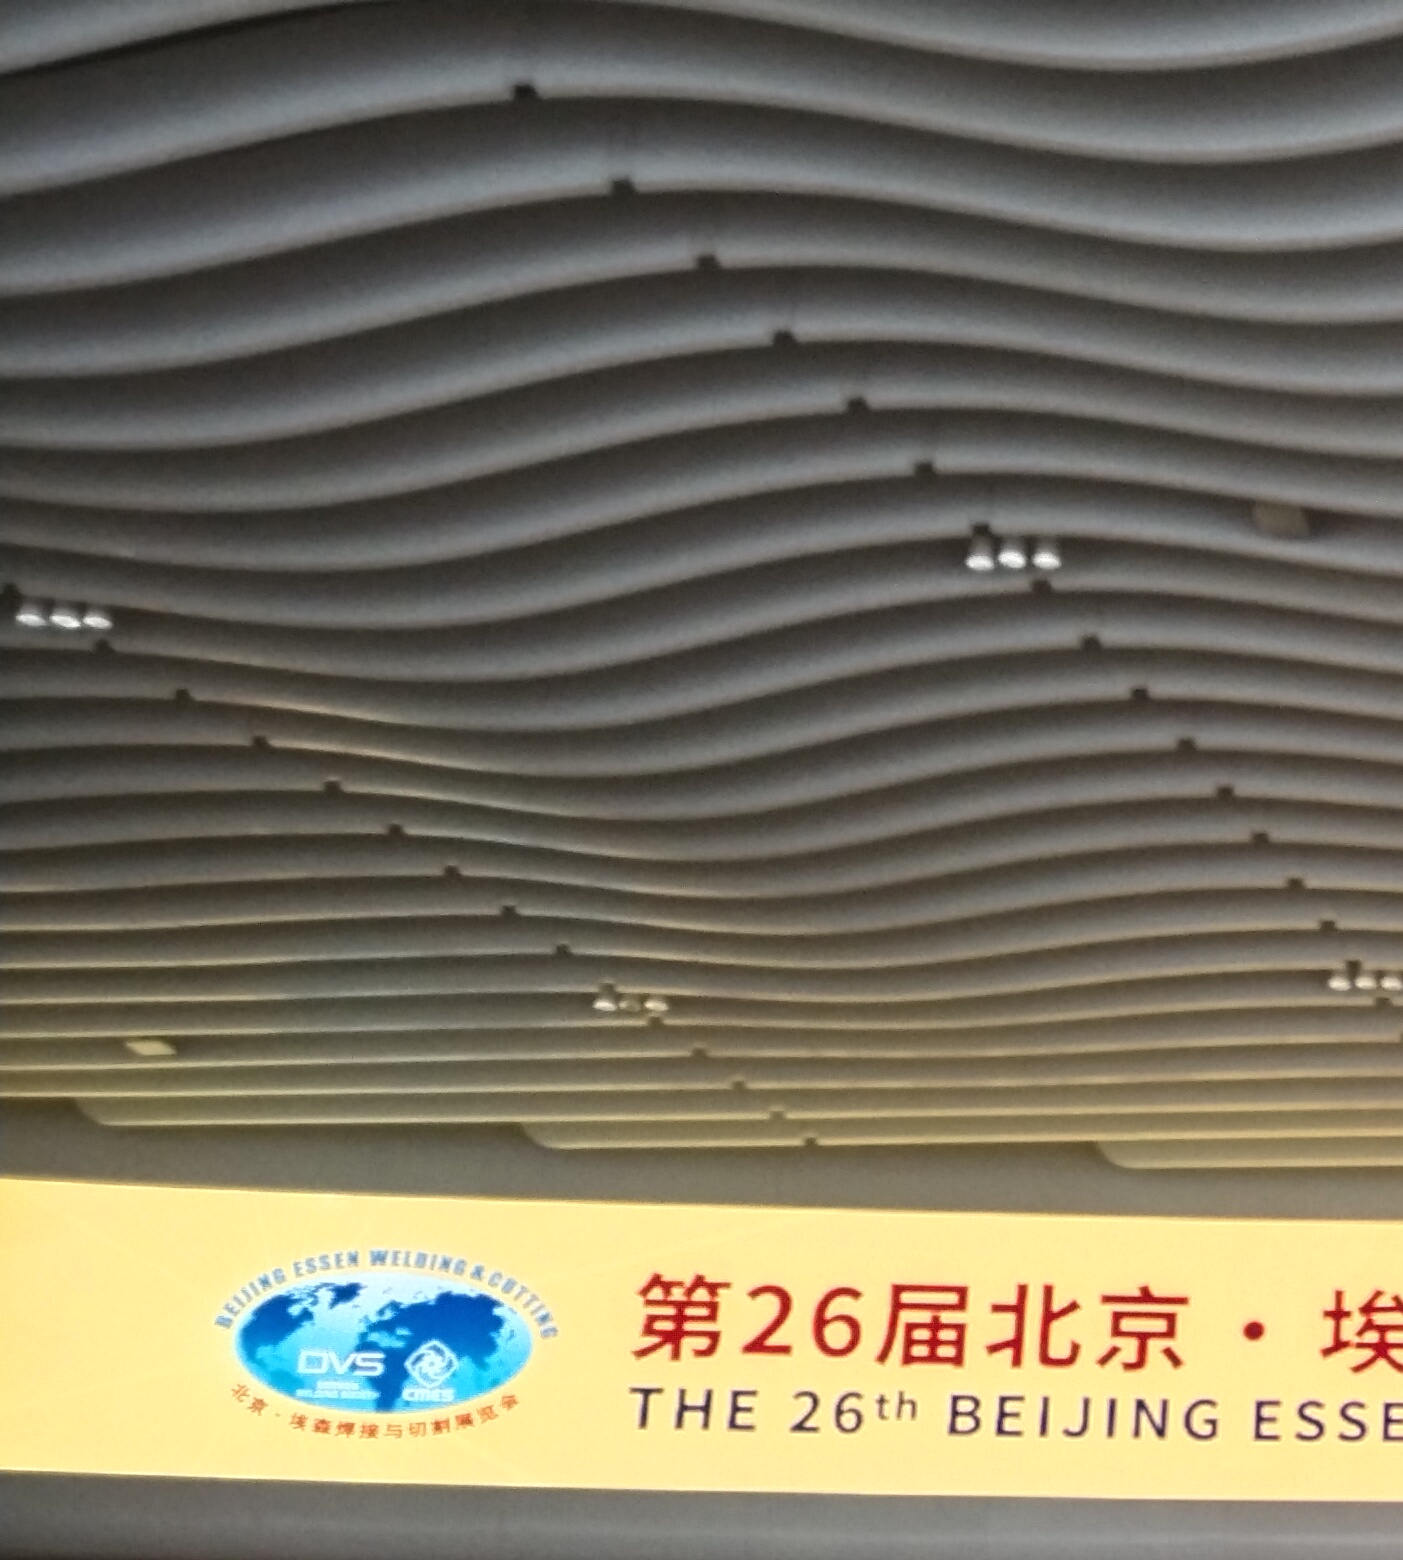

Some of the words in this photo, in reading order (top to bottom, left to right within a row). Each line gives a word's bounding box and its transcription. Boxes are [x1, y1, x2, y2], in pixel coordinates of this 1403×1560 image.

[292, 1250, 359, 1278] ESSEN
[296, 1348, 387, 1377] DVS
[628, 1386, 759, 1433] THE
[789, 1390, 918, 1435] 26th
[946, 1393, 1219, 1442] BEIJING
